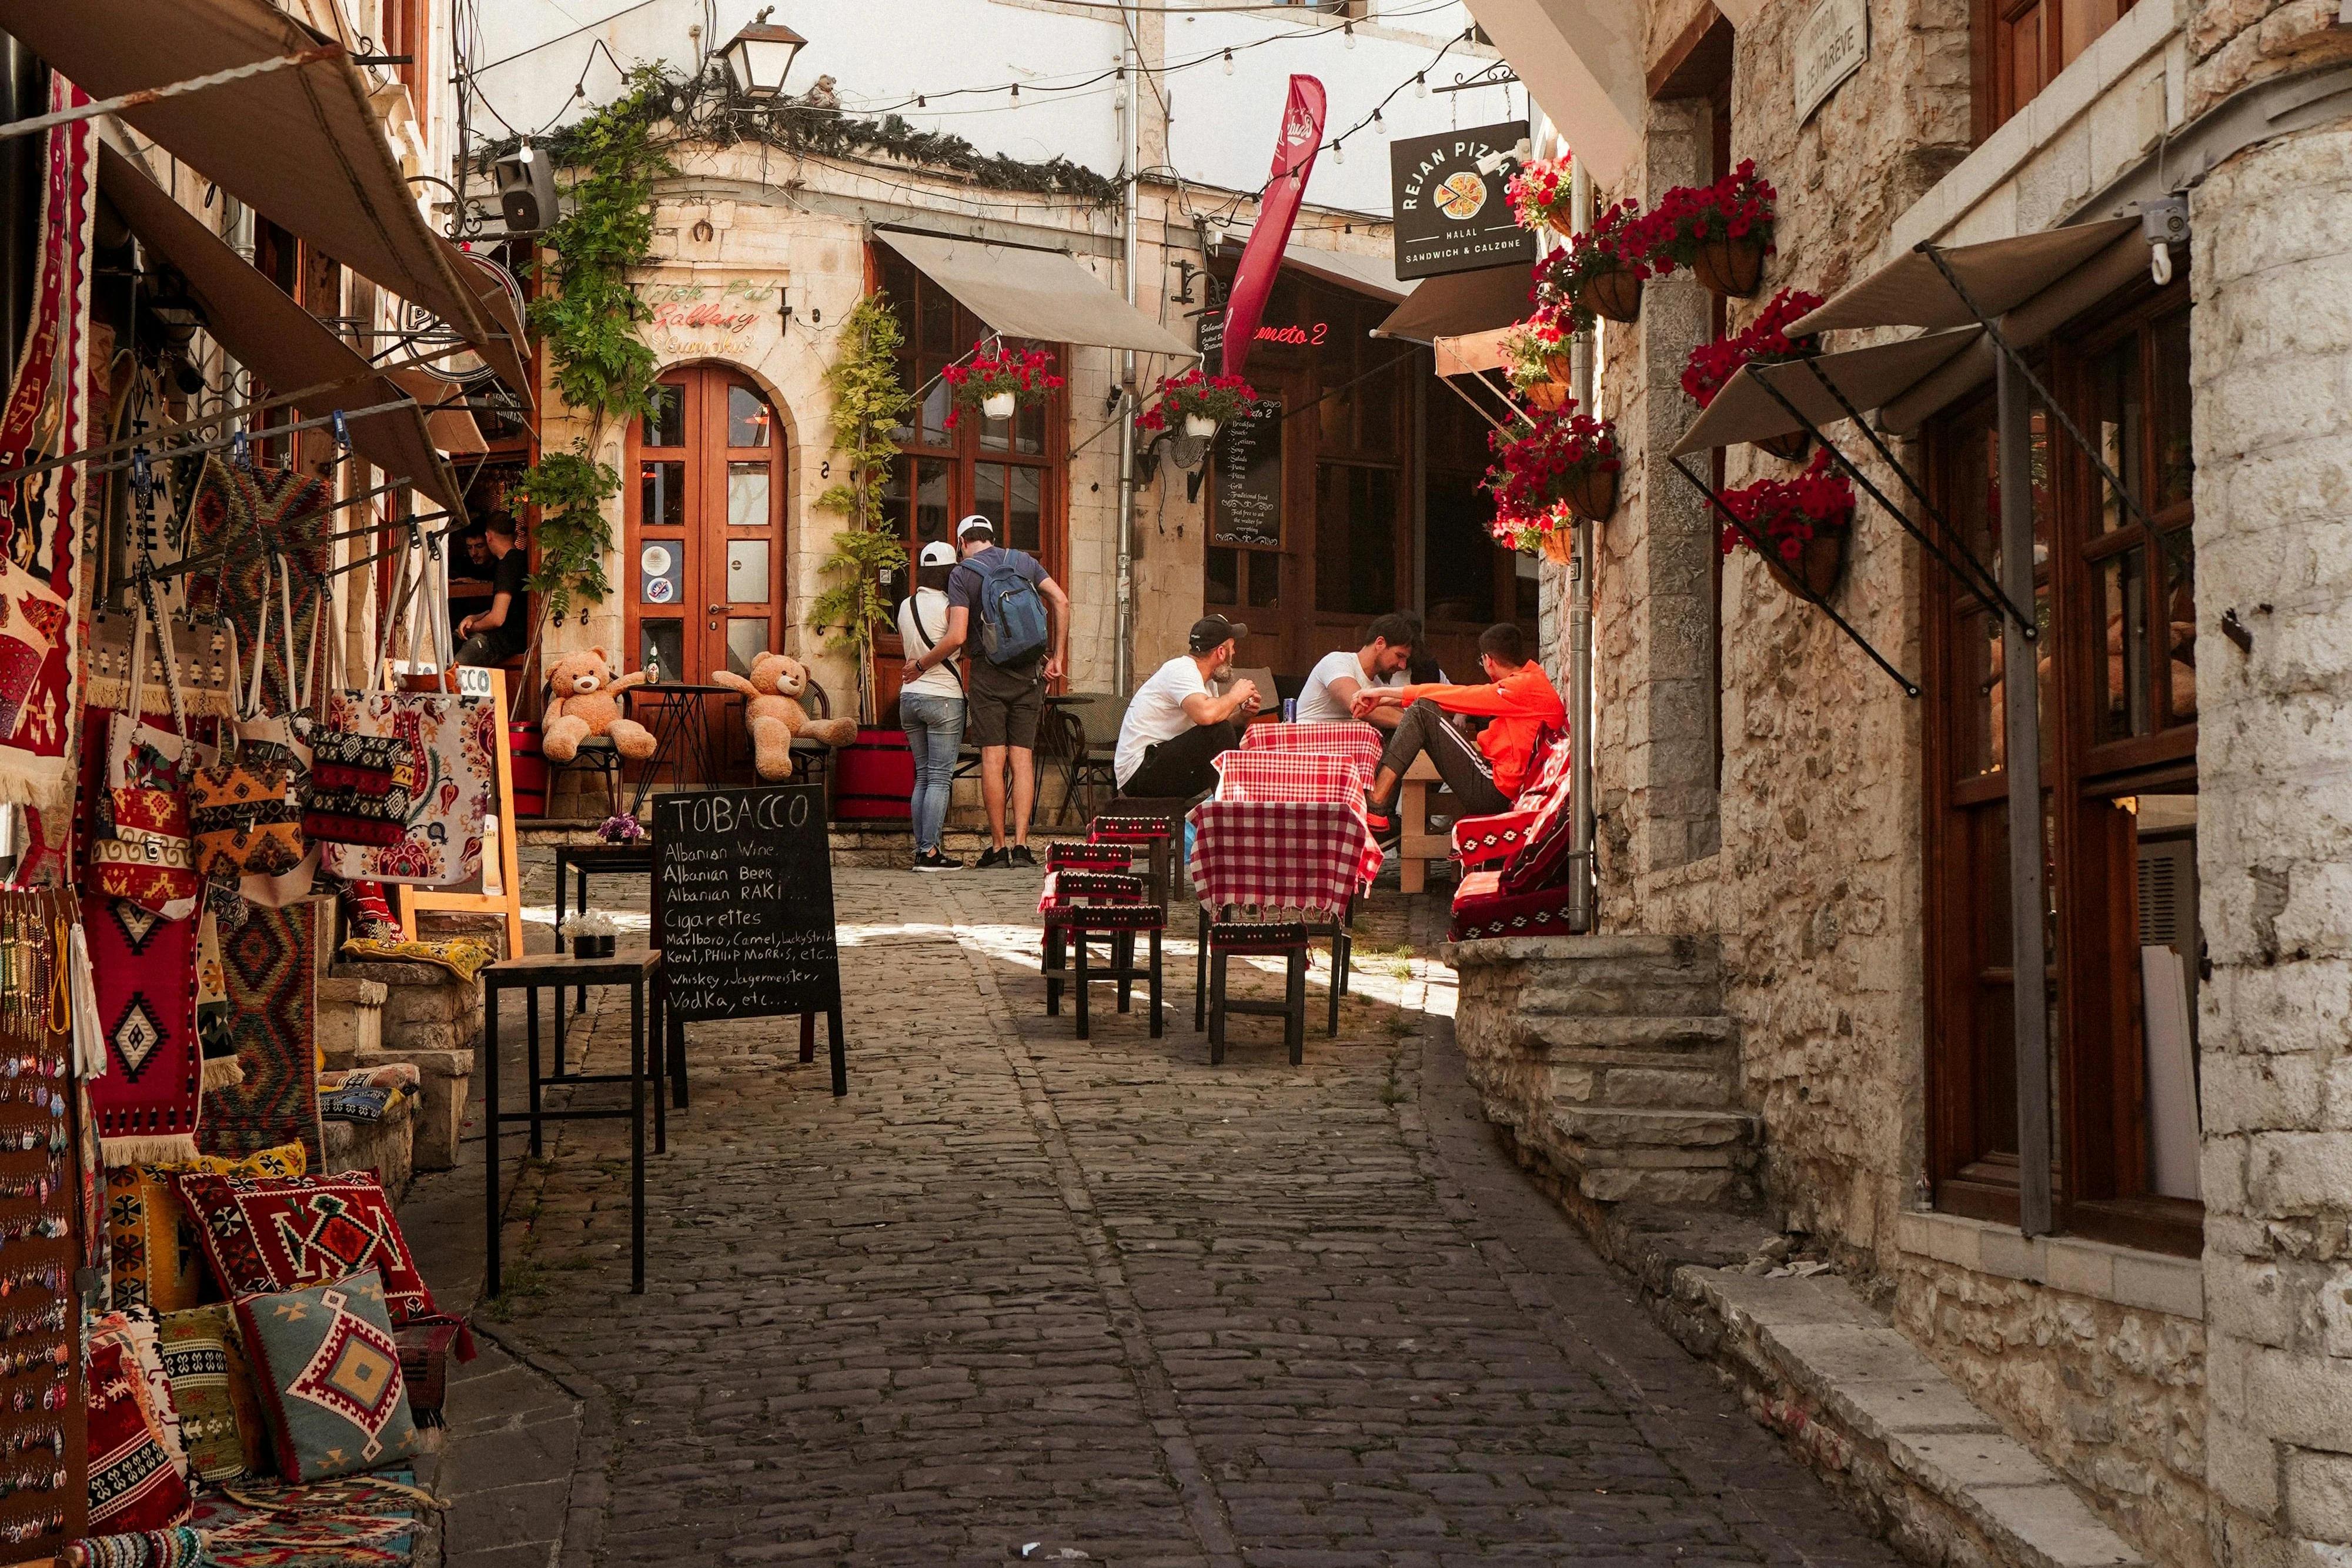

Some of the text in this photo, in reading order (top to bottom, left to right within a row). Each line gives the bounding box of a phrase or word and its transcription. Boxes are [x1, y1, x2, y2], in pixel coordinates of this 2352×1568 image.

[1403, 142, 1510, 209] REJAN PIZA
[1446, 228, 1477, 239] HALAL
[1406, 249, 1459, 263] SANDWICH
[642, 279, 778, 302] Irish Pub
[652, 303, 760, 333] Gallery
[1254, 323, 1328, 345] meto 2
[1265, 409, 1272, 418] 2
[1242, 509, 1252, 517] free
[669, 794, 808, 833] TOBACCO
[664, 842, 727, 861] Albanian
[663, 864, 728, 884] Albanian
[667, 887, 730, 902] Albanian
[665, 909, 761, 937] Cigarettes
